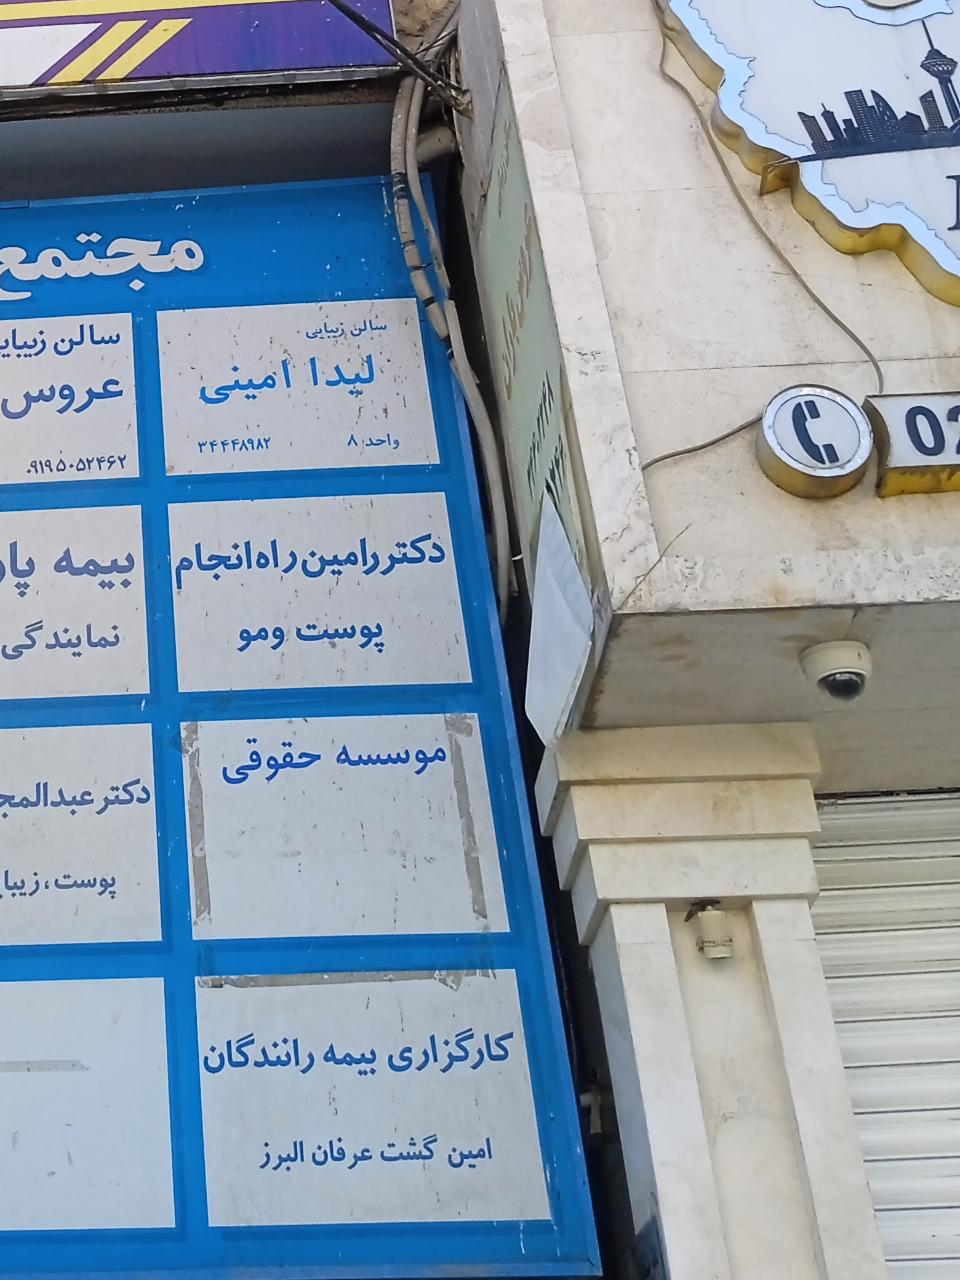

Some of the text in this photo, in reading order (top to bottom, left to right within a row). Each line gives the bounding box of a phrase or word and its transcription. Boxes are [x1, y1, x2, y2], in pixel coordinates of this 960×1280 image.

[53, 322, 121, 356] سالن
[305, 319, 388, 341] سالن زیبایی
[0, 377, 125, 420] عروس
[198, 353, 377, 405] لیدا امینی
[197, 433, 401, 454] واحد ۸ ۳۴۴۴۸۹۸۲
[53, 546, 136, 591] بیمه
[301, 537, 380, 578] رامین
[380, 533, 446, 576] دکتر
[1, 620, 121, 660] نمایندگی
[295, 622, 385, 654] پوست
[222, 737, 448, 785] موسسه حقوقی
[95, 778, 152, 815] دکتر
[203, 1027, 514, 1077] کارگزاری بیمه رانندگان
[259, 1133, 493, 1172] امین گشت عرفان البرز
